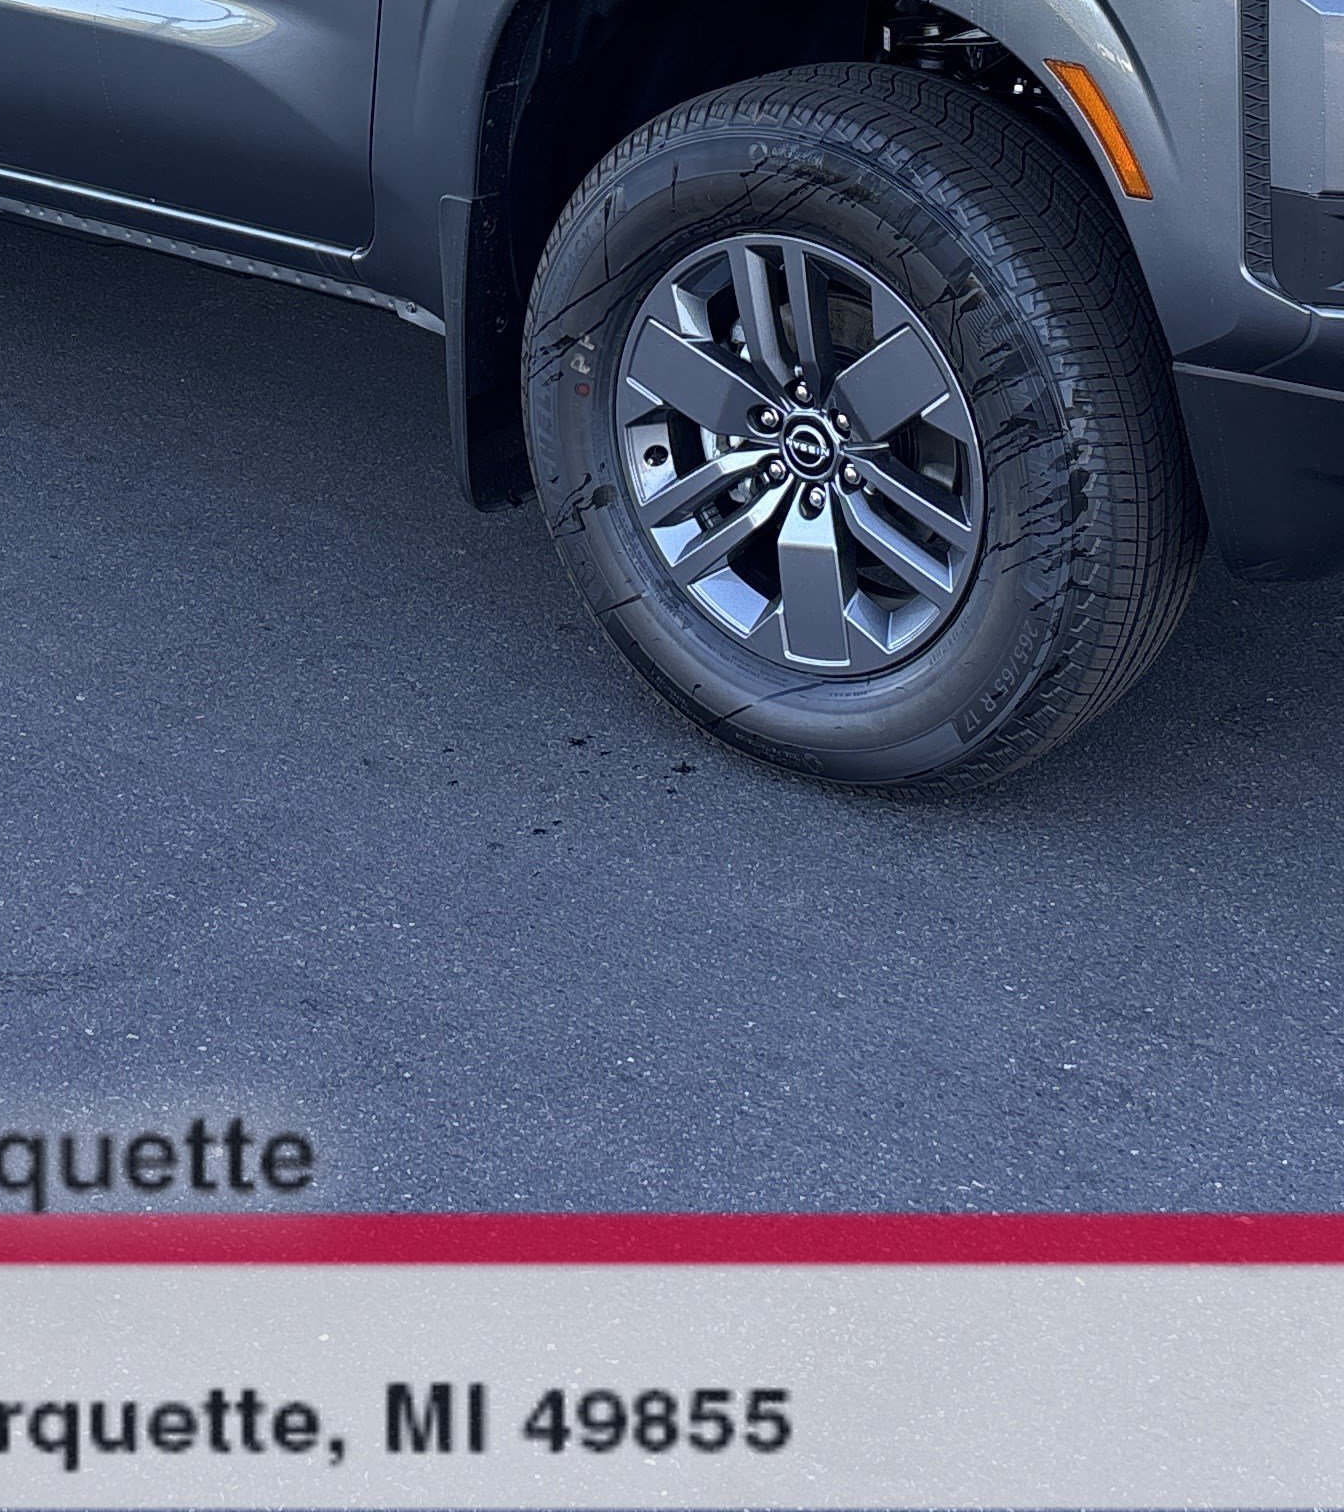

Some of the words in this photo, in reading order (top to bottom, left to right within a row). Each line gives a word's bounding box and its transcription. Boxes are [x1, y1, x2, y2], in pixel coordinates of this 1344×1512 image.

[785, 437, 830, 458] NISSAN
[993, 618, 1039, 697] 265/65
[979, 691, 998, 713] R
[962, 708, 982, 734] 17
